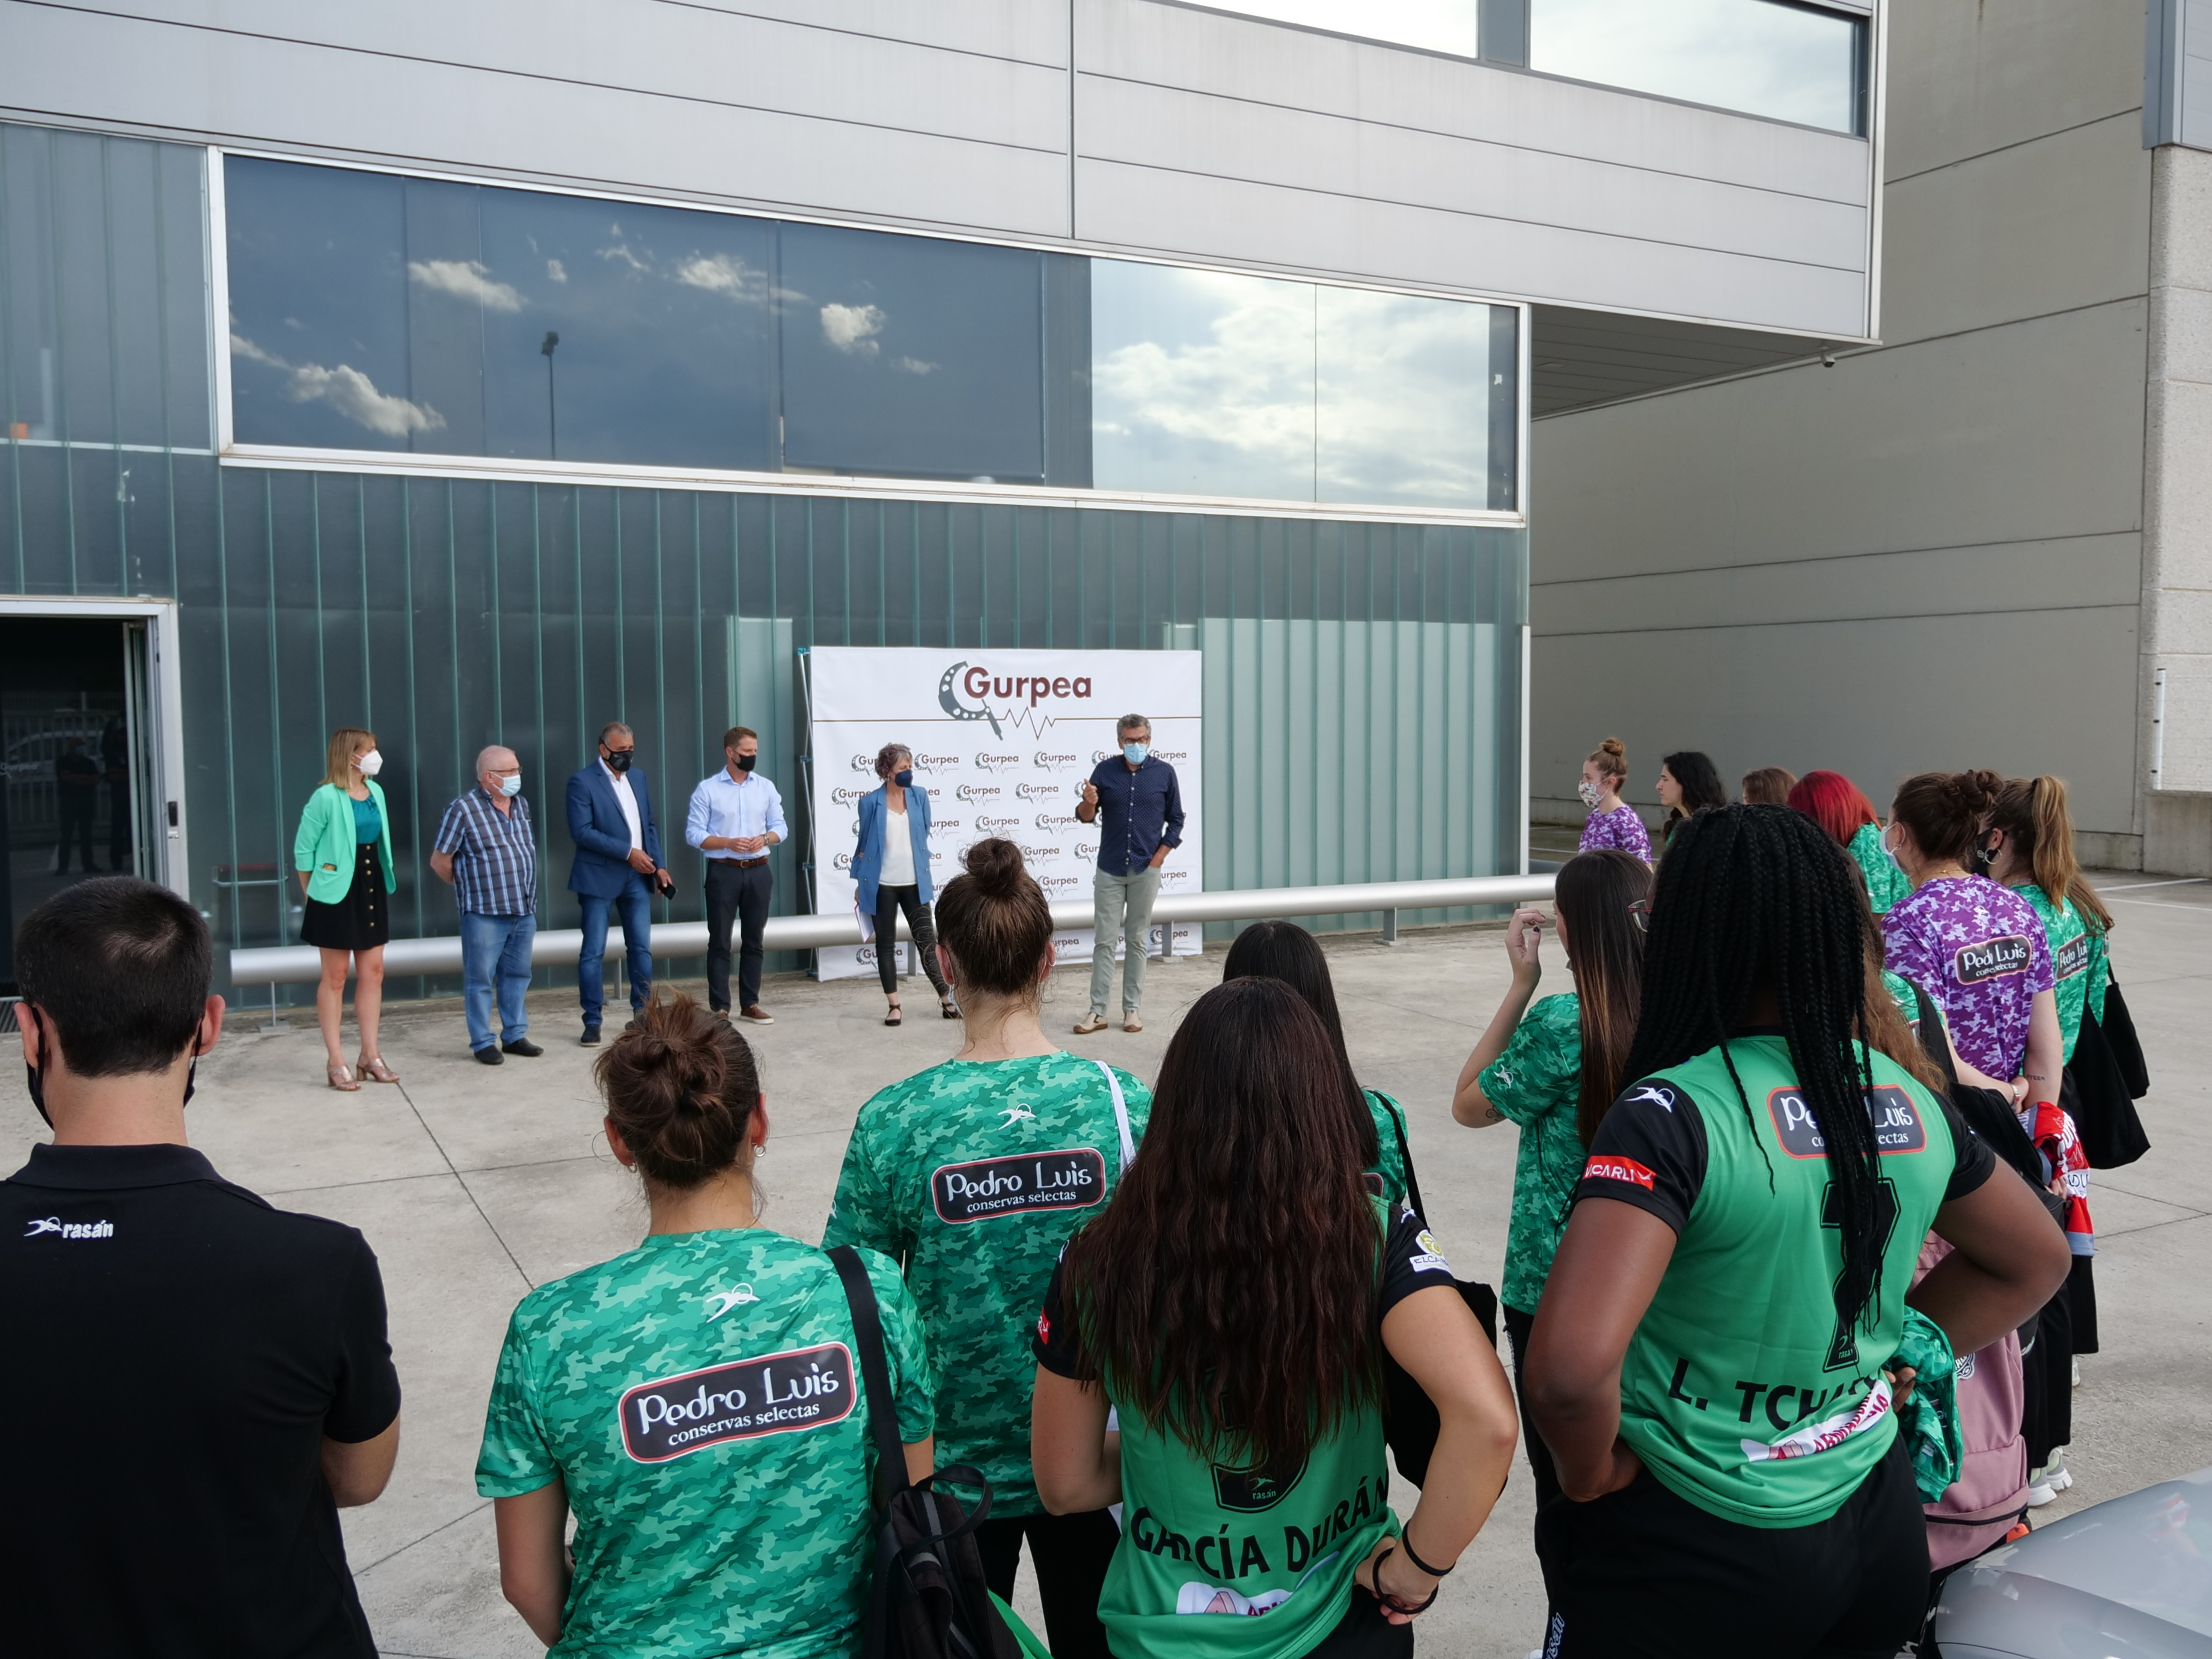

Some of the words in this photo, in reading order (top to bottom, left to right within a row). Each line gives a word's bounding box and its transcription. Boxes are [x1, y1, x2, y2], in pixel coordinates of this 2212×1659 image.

[964, 667, 1092, 707] Gurpea
[921, 755, 959, 766] Gurpea
[982, 754, 1019, 765] Gurpea
[1040, 753, 1076, 762] Gurpea
[1153, 750, 1187, 761] Gurpea
[963, 785, 1000, 796] Gurpea
[1022, 783, 1059, 794] Gurpea
[930, 820, 959, 830] urpea
[982, 817, 1019, 826] Gurpea
[1025, 846, 1060, 857] Gurpea
[1042, 876, 1078, 887] Gurpea
[1161, 872, 1187, 881] urpea
[1996, 943, 2026, 962] Luis
[946, 1170, 1022, 1202] Pedro
[1036, 1161, 1092, 1190] Luis
[967, 1194, 1025, 1213] conservas
[1028, 1191, 1077, 1203] selectas
[62, 1220, 114, 1239] rasán
[1668, 1356, 1709, 1411] L.
[638, 1385, 747, 1435] Pedro
[763, 1362, 839, 1405] Luis
[668, 1413, 752, 1446] conservas
[756, 1402, 820, 1425] selectas
[1252, 1488, 1277, 1500] rasán
[1131, 1506, 1271, 1580] GARCÍA
[1283, 1468, 1389, 1572] DURÁN
